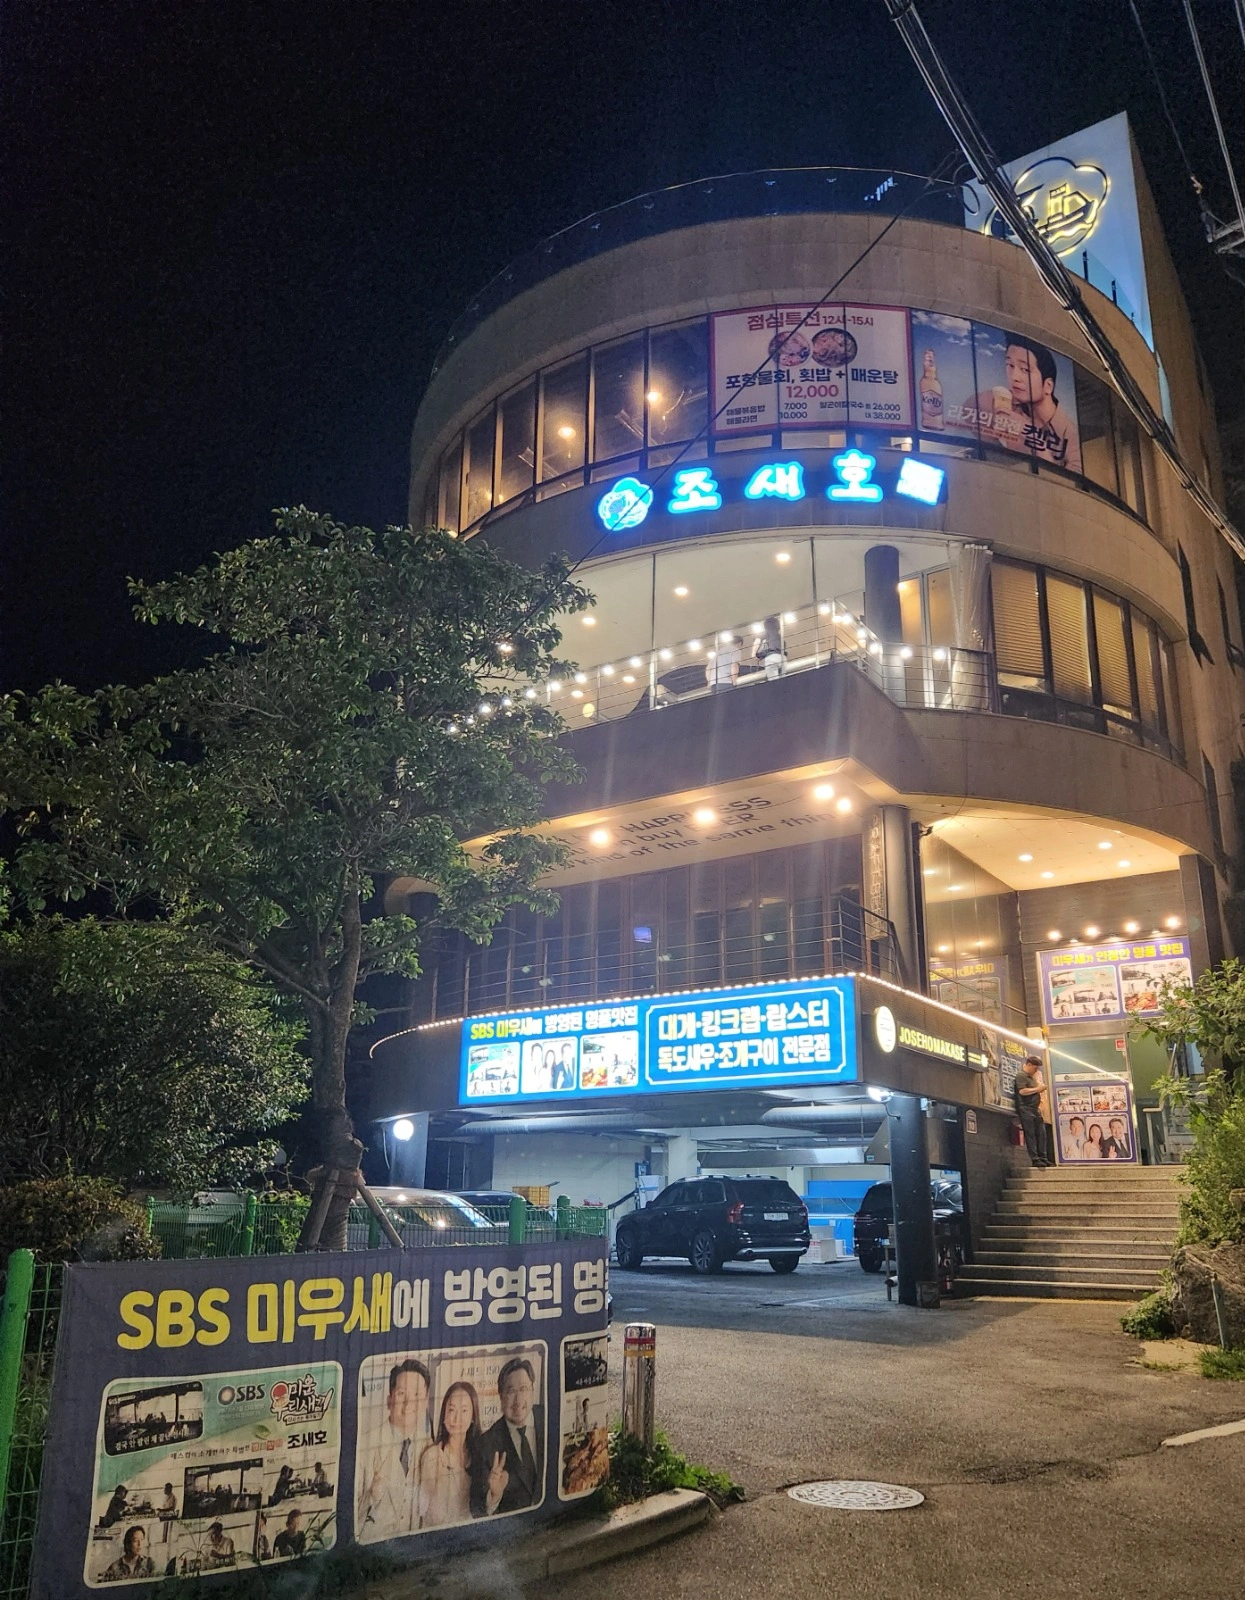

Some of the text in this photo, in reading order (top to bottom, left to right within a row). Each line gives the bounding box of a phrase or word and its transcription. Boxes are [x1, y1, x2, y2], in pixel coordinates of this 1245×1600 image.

[747, 311, 821, 331] 점심특선
[799, 368, 832, 382] 횟밥
[851, 368, 899, 385] 매운탕
[785, 384, 840, 399] 12,000
[784, 402, 808, 410] 7,000
[872, 402, 901, 412] 26,000
[948, 404, 993, 427] 라거의
[726, 414, 758, 426] 해물라면
[630, 846, 655, 857] of
[657, 838, 702, 850] the
[705, 824, 777, 842] same
[636, 828, 684, 842] buy
[1159, 942, 1184, 956] 맛집
[470, 1021, 495, 1040] SBS
[781, 1032, 831, 1065] 전문점
[899, 1026, 967, 1062] JOSEHOMAKASE
[116, 1257, 609, 1350] SBS 미우새에 방영된 명
[235, 1384, 266, 1402] SBS
[287, 1429, 328, 1450] 조새호
